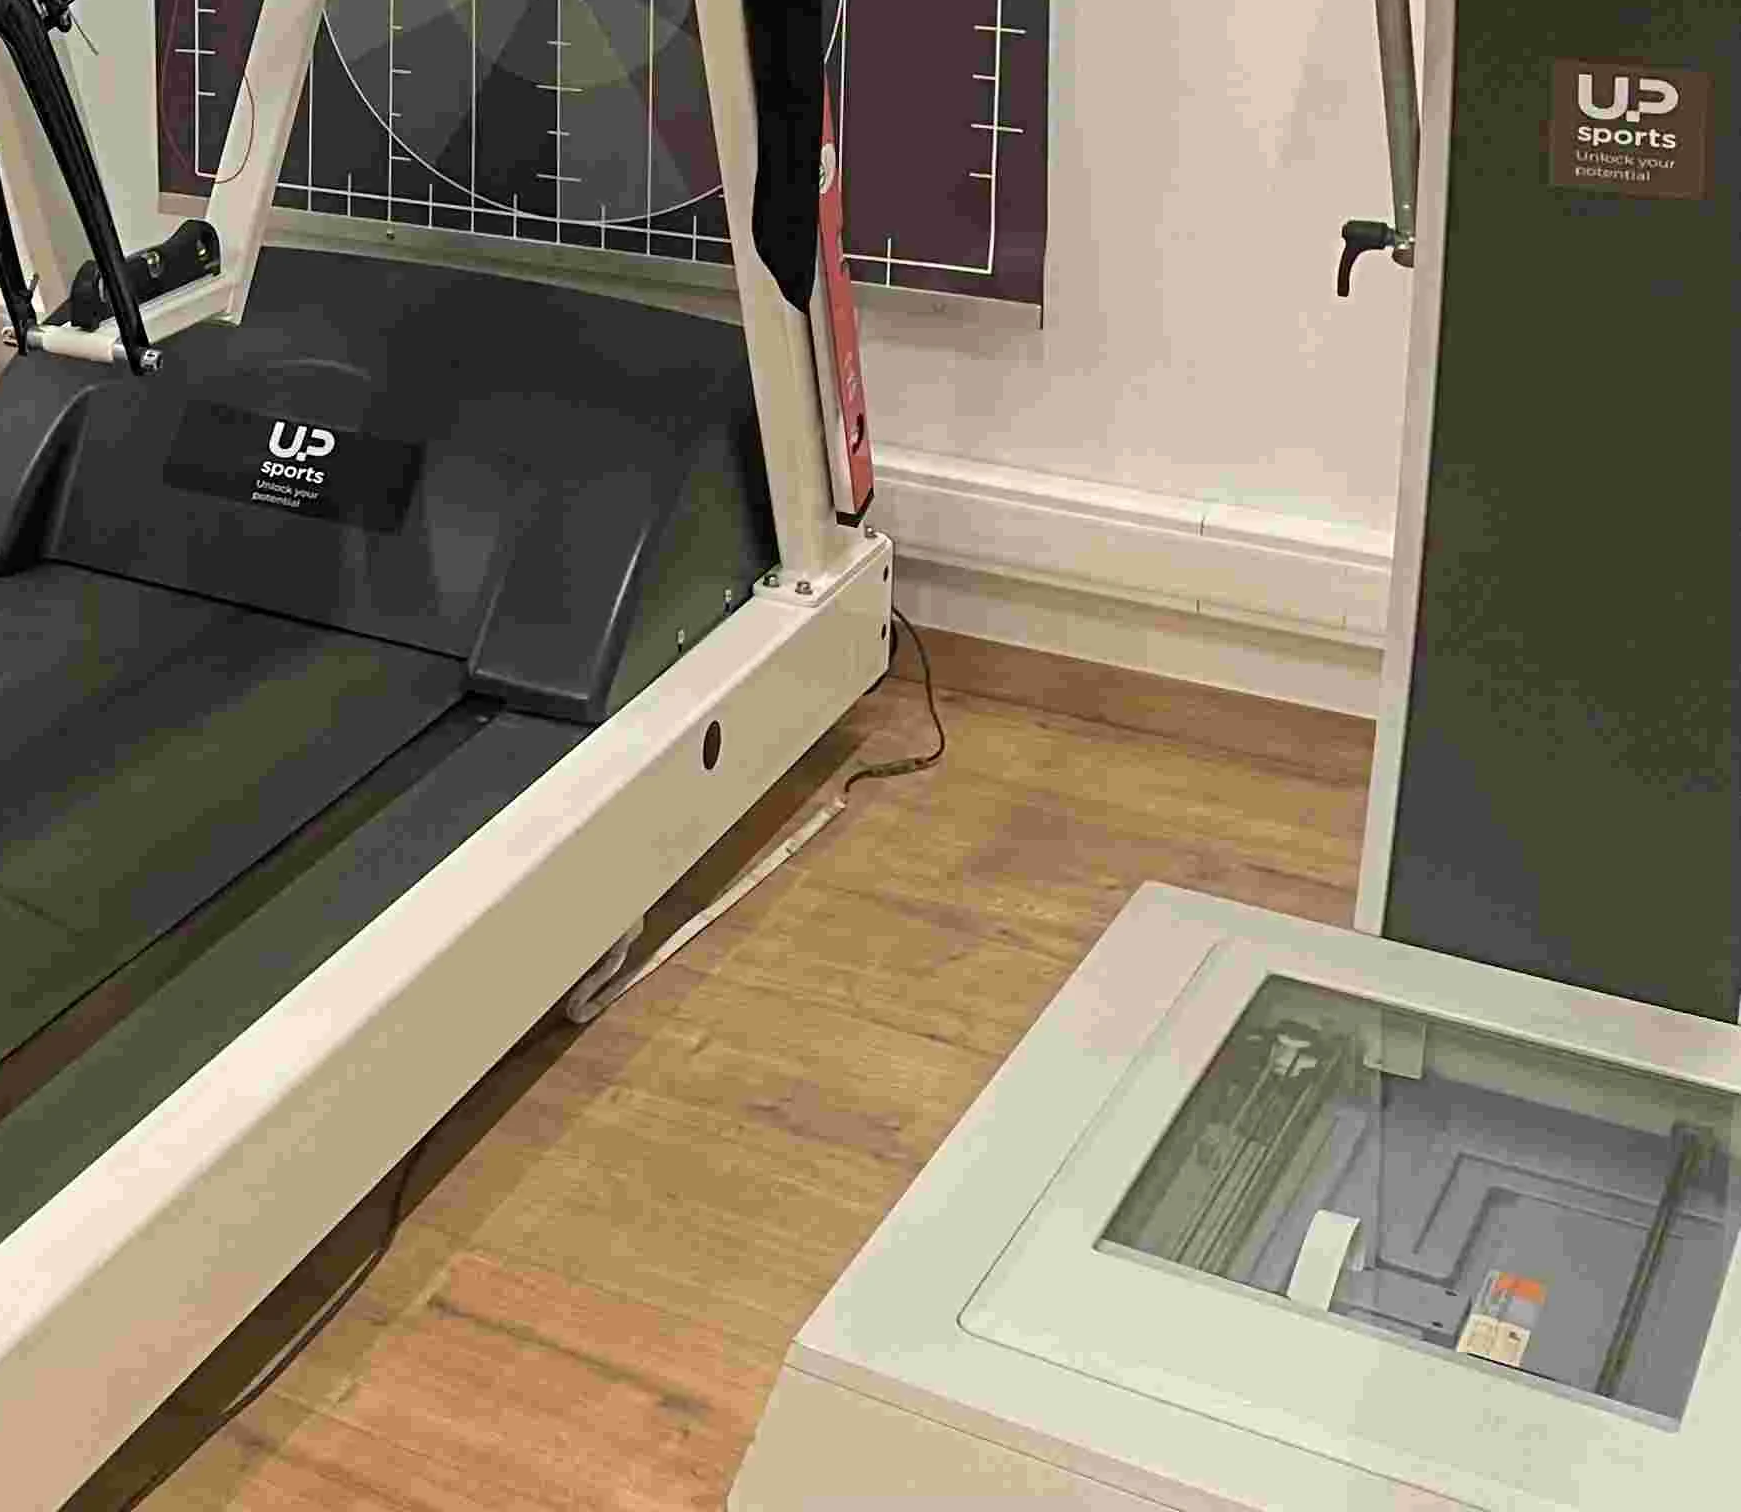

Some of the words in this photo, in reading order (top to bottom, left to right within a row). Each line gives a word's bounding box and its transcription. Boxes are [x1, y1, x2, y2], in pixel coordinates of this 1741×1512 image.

[1577, 125, 1676, 149] sports
[1575, 149, 1635, 166] Unlock
[1637, 157, 1676, 169] your
[1574, 166, 1651, 182] potential
[261, 460, 324, 484] sports
[251, 491, 301, 508] potential
[256, 479, 293, 495] Unlock
[294, 487, 319, 500] your
